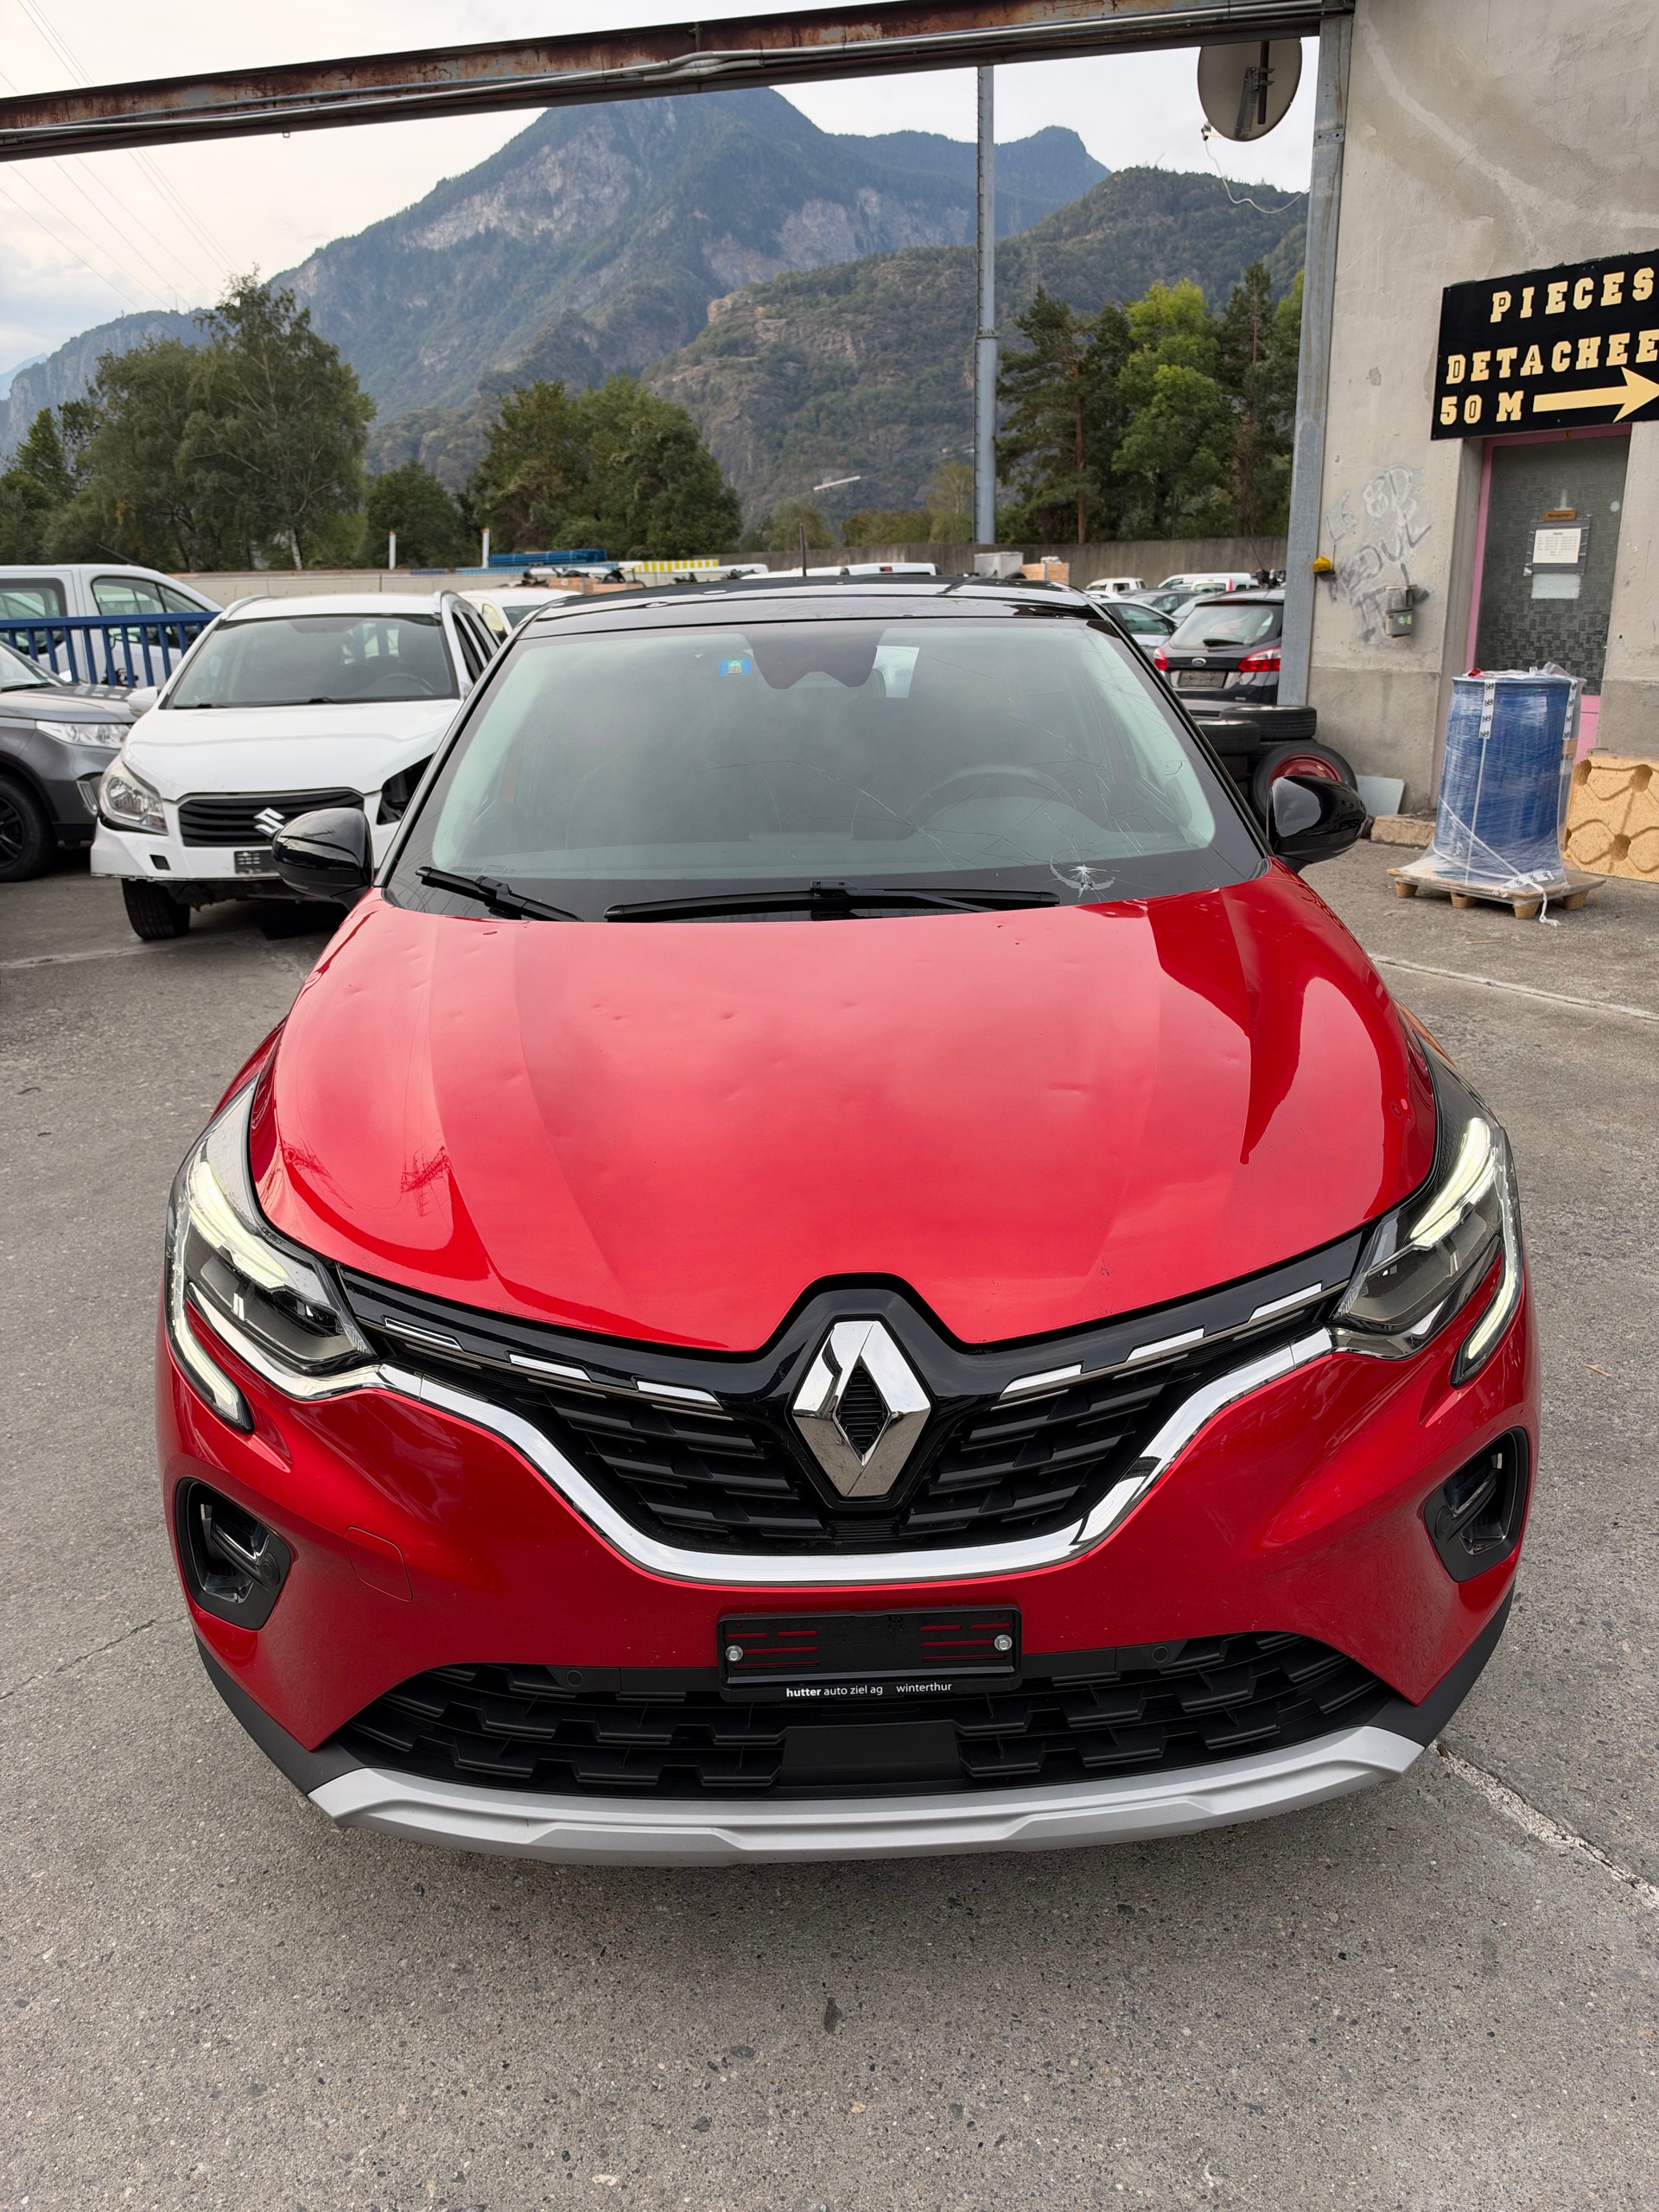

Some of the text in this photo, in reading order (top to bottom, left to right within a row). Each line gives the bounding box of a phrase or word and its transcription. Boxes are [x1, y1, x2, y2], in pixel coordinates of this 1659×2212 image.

[1490, 267, 1655, 323] PIECES
[1446, 328, 1659, 385] DETACHEE
[1440, 391, 1524, 426] 50 M
[785, 1681, 952, 1698] hutter auto ziel ag winterthur
